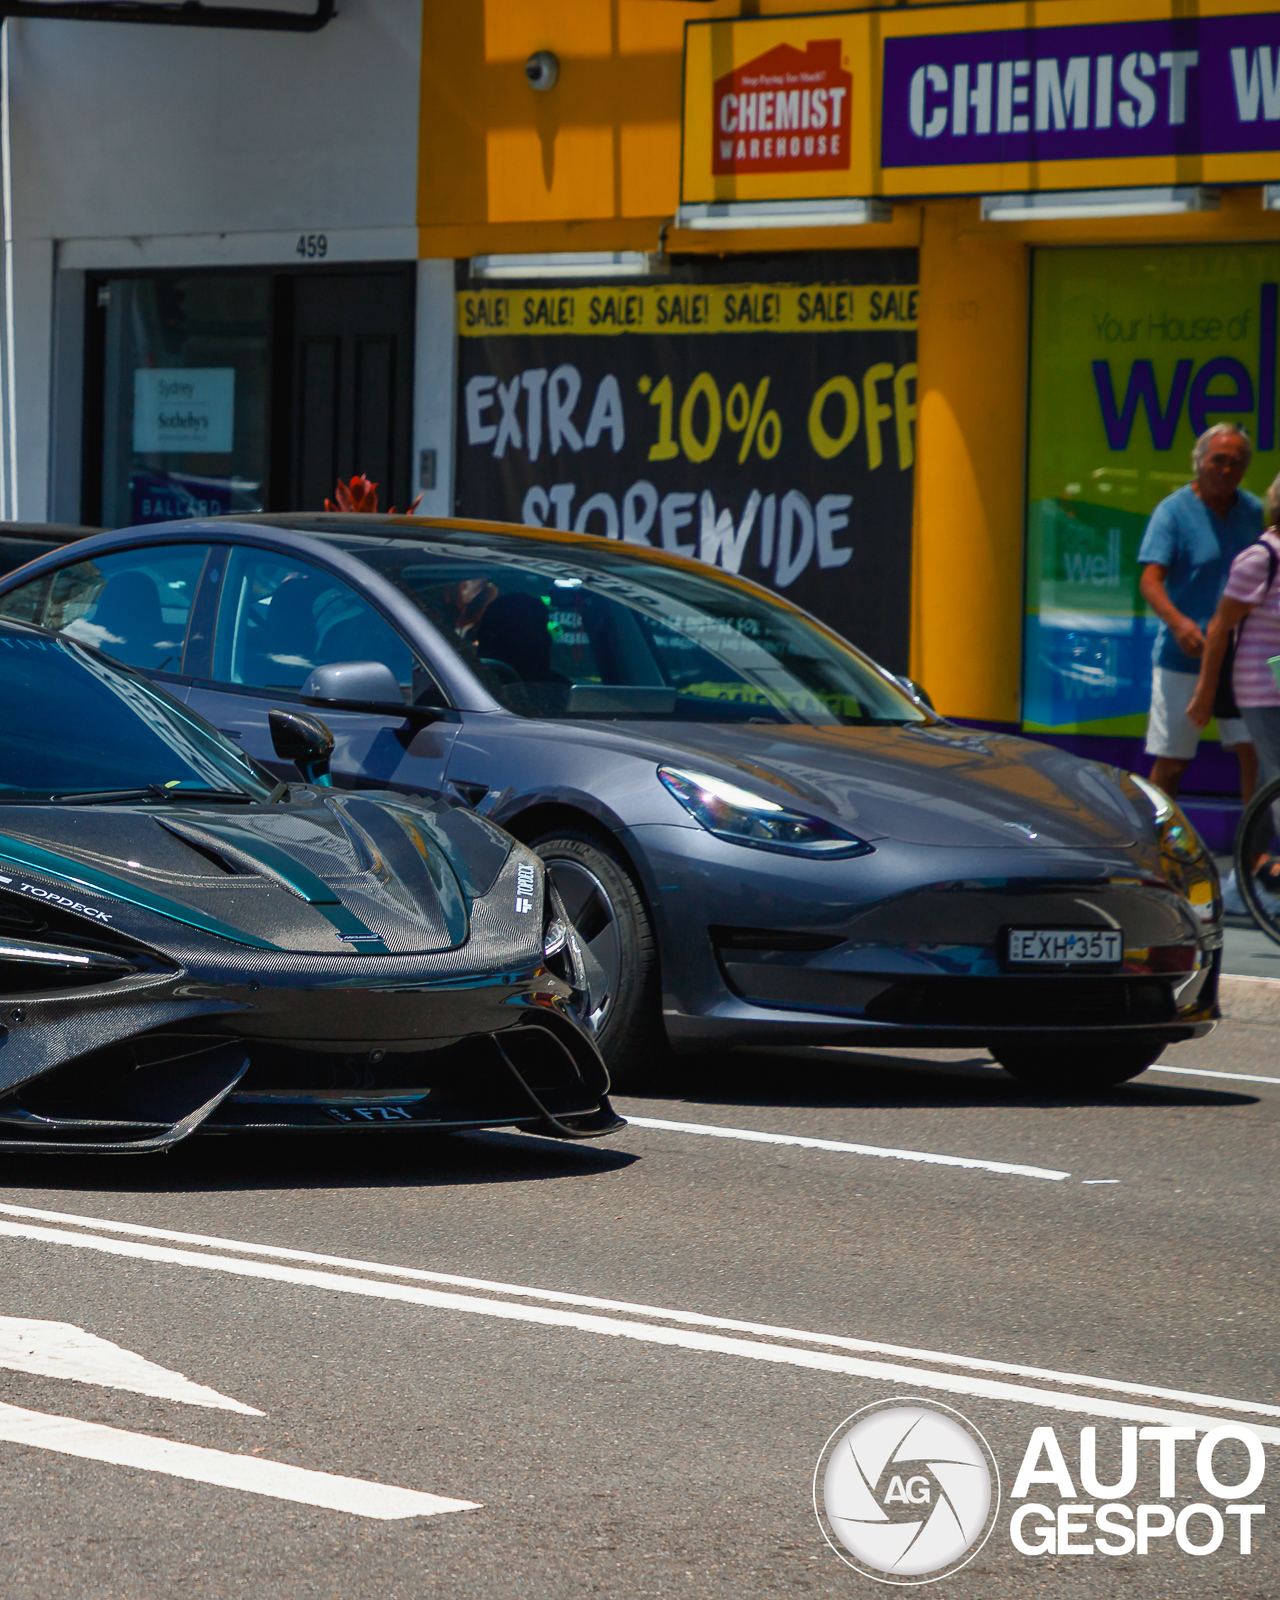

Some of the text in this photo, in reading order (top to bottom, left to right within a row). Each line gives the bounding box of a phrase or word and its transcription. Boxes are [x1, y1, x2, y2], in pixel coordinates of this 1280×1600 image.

[720, 86, 847, 134] CHEMIST
[909, 51, 1199, 139] CHEMIST
[720, 134, 841, 160] WAREHOUSE
[296, 233, 328, 258] 459
[465, 298, 509, 327] SALE!
[523, 297, 575, 327] SALE!
[589, 296, 643, 326] SALE!
[657, 294, 709, 326] SALE!
[724, 292, 780, 324] SALE!
[798, 291, 854, 323] SALE!
[1092, 306, 1252, 343] Your House of
[157, 379, 196, 400] Sydney
[157, 410, 210, 431] Sotheby's
[465, 363, 625, 462] EXTRA
[517, 862, 535, 897] TOPDECK
[21, 882, 113, 922] TOPDECK
